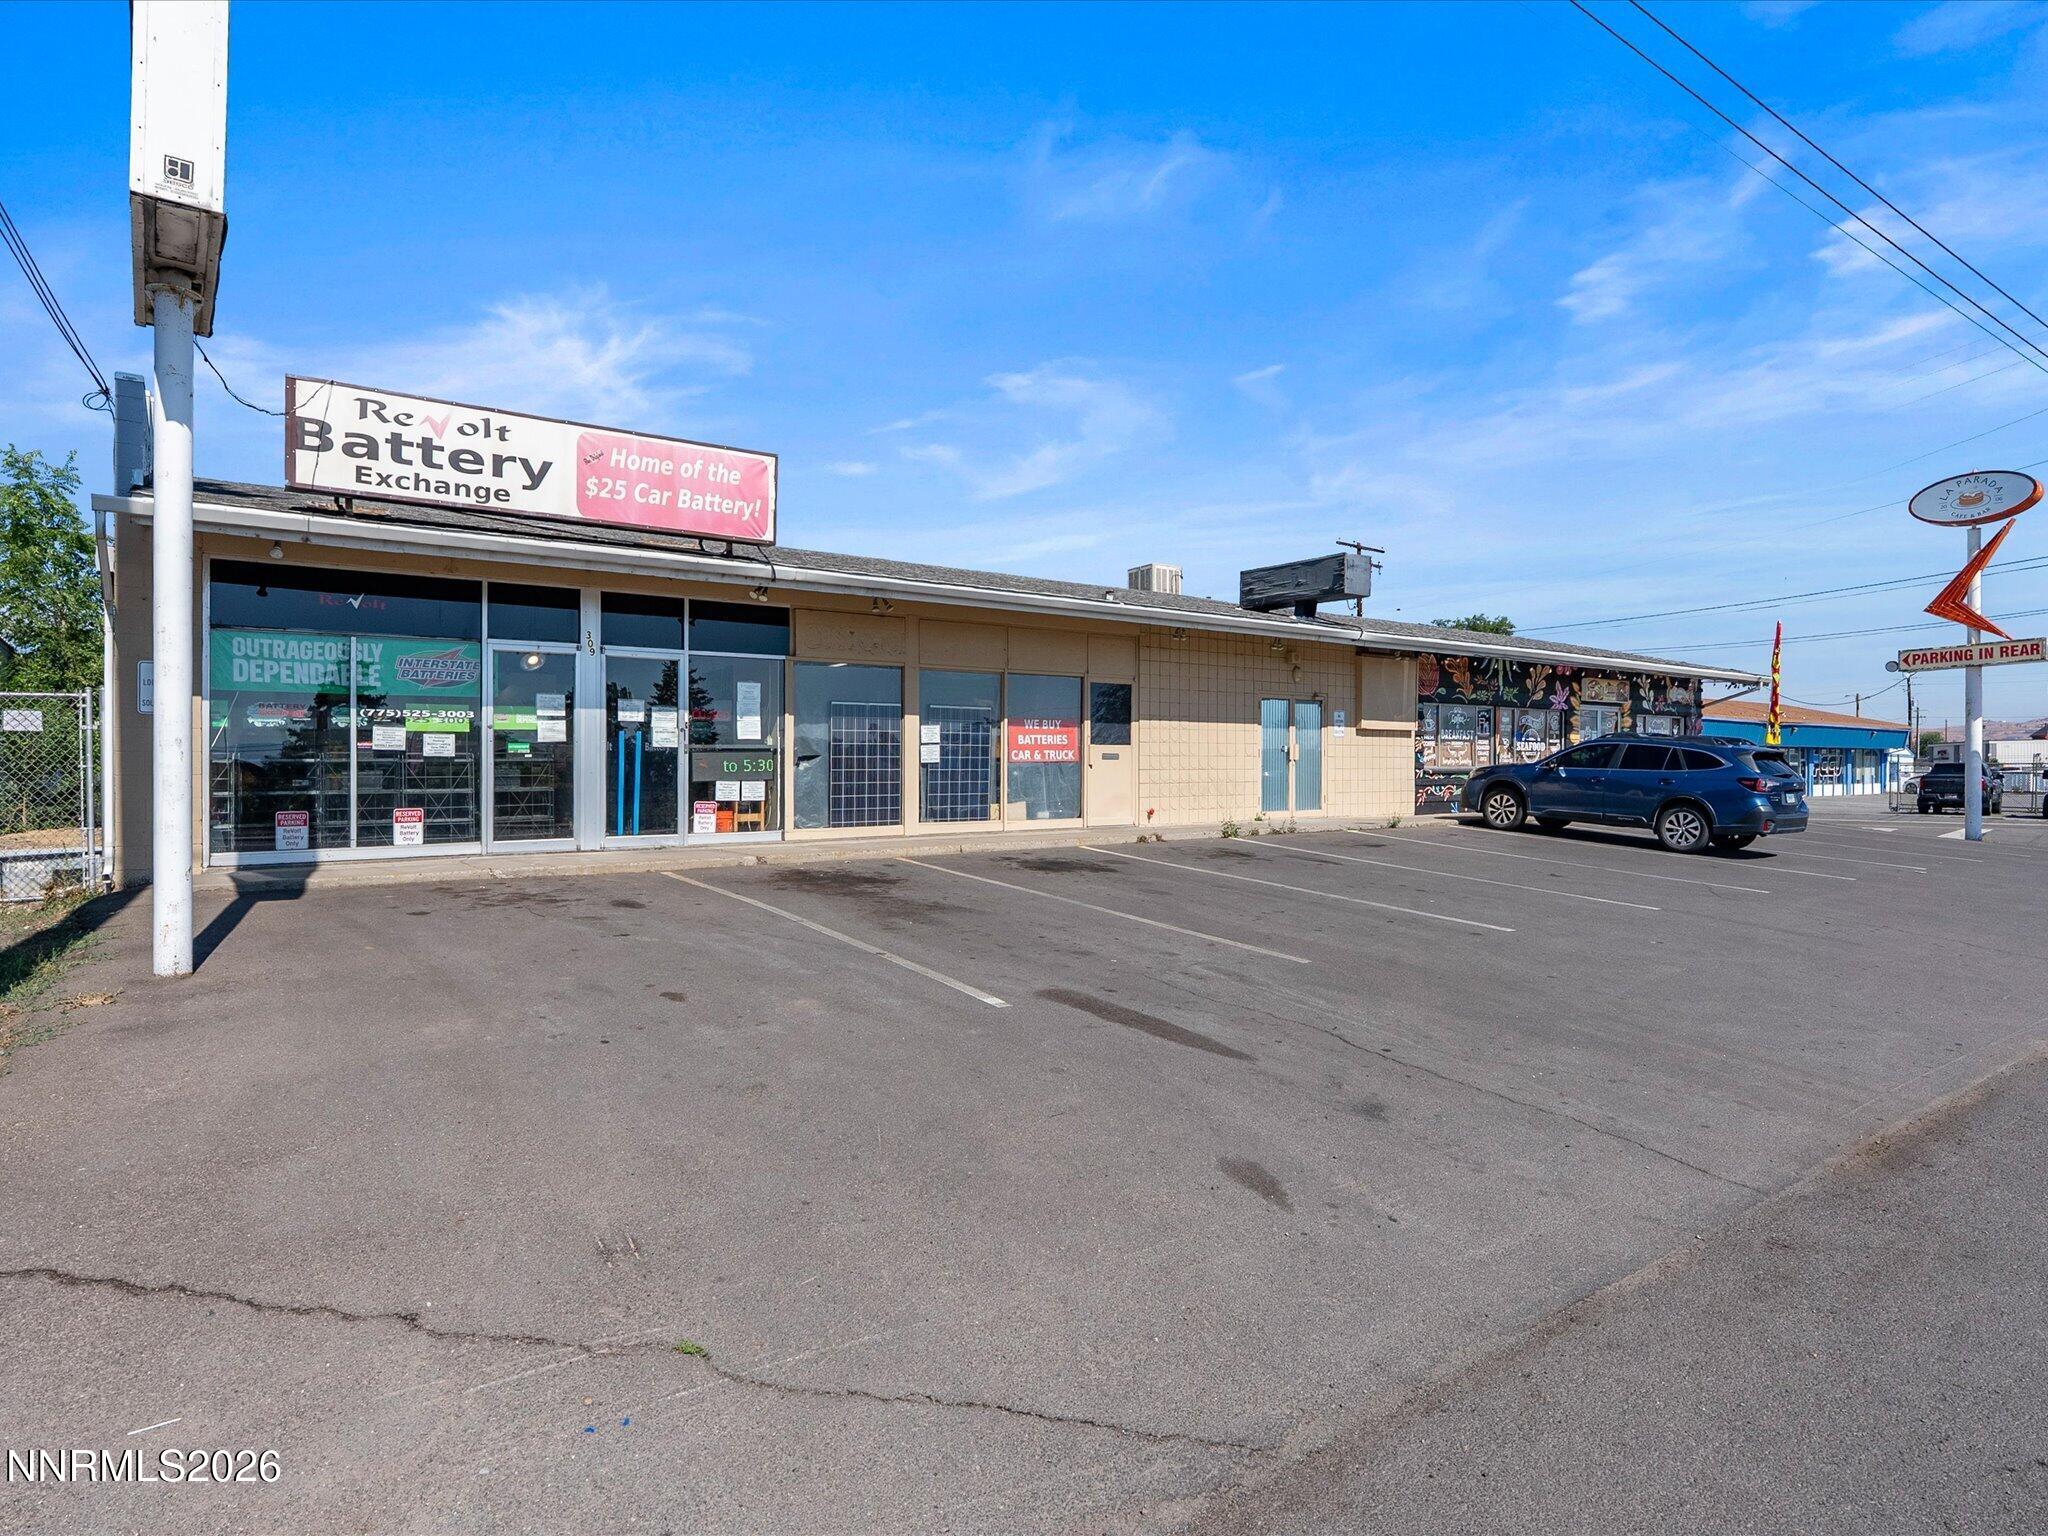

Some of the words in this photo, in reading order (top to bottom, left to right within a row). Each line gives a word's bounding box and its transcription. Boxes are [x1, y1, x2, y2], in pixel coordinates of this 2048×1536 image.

[296, 416, 553, 490] Battery
[609, 448, 674, 476] Home
[680, 459, 703, 479] of
[707, 462, 742, 485] the
[355, 466, 510, 503] Exchange
[1939, 488, 1954, 501] LA
[1956, 475, 2004, 494] PARADA
[585, 475, 627, 499] $25
[634, 482, 672, 506] Car
[677, 488, 762, 521] Battery!
[586, 630, 596, 656] 309
[1912, 649, 1974, 665] PARKING
[1979, 647, 1994, 660] IN
[2000, 643, 2041, 658] REAR
[397, 656, 480, 671] INTERSTATE
[398, 668, 478, 682] BATTERIES
[1024, 719, 1040, 729] WE
[1042, 719, 1062, 730] BUY
[1018, 734, 1068, 745] BATTERIES
[1516, 742, 1546, 751] SEAFOOD
[1011, 749, 1031, 760] CAR
[1033, 750, 1042, 760] &
[1044, 750, 1075, 760] TRUCK
[723, 760, 738, 773] to
[743, 759, 774, 772] 5:30
